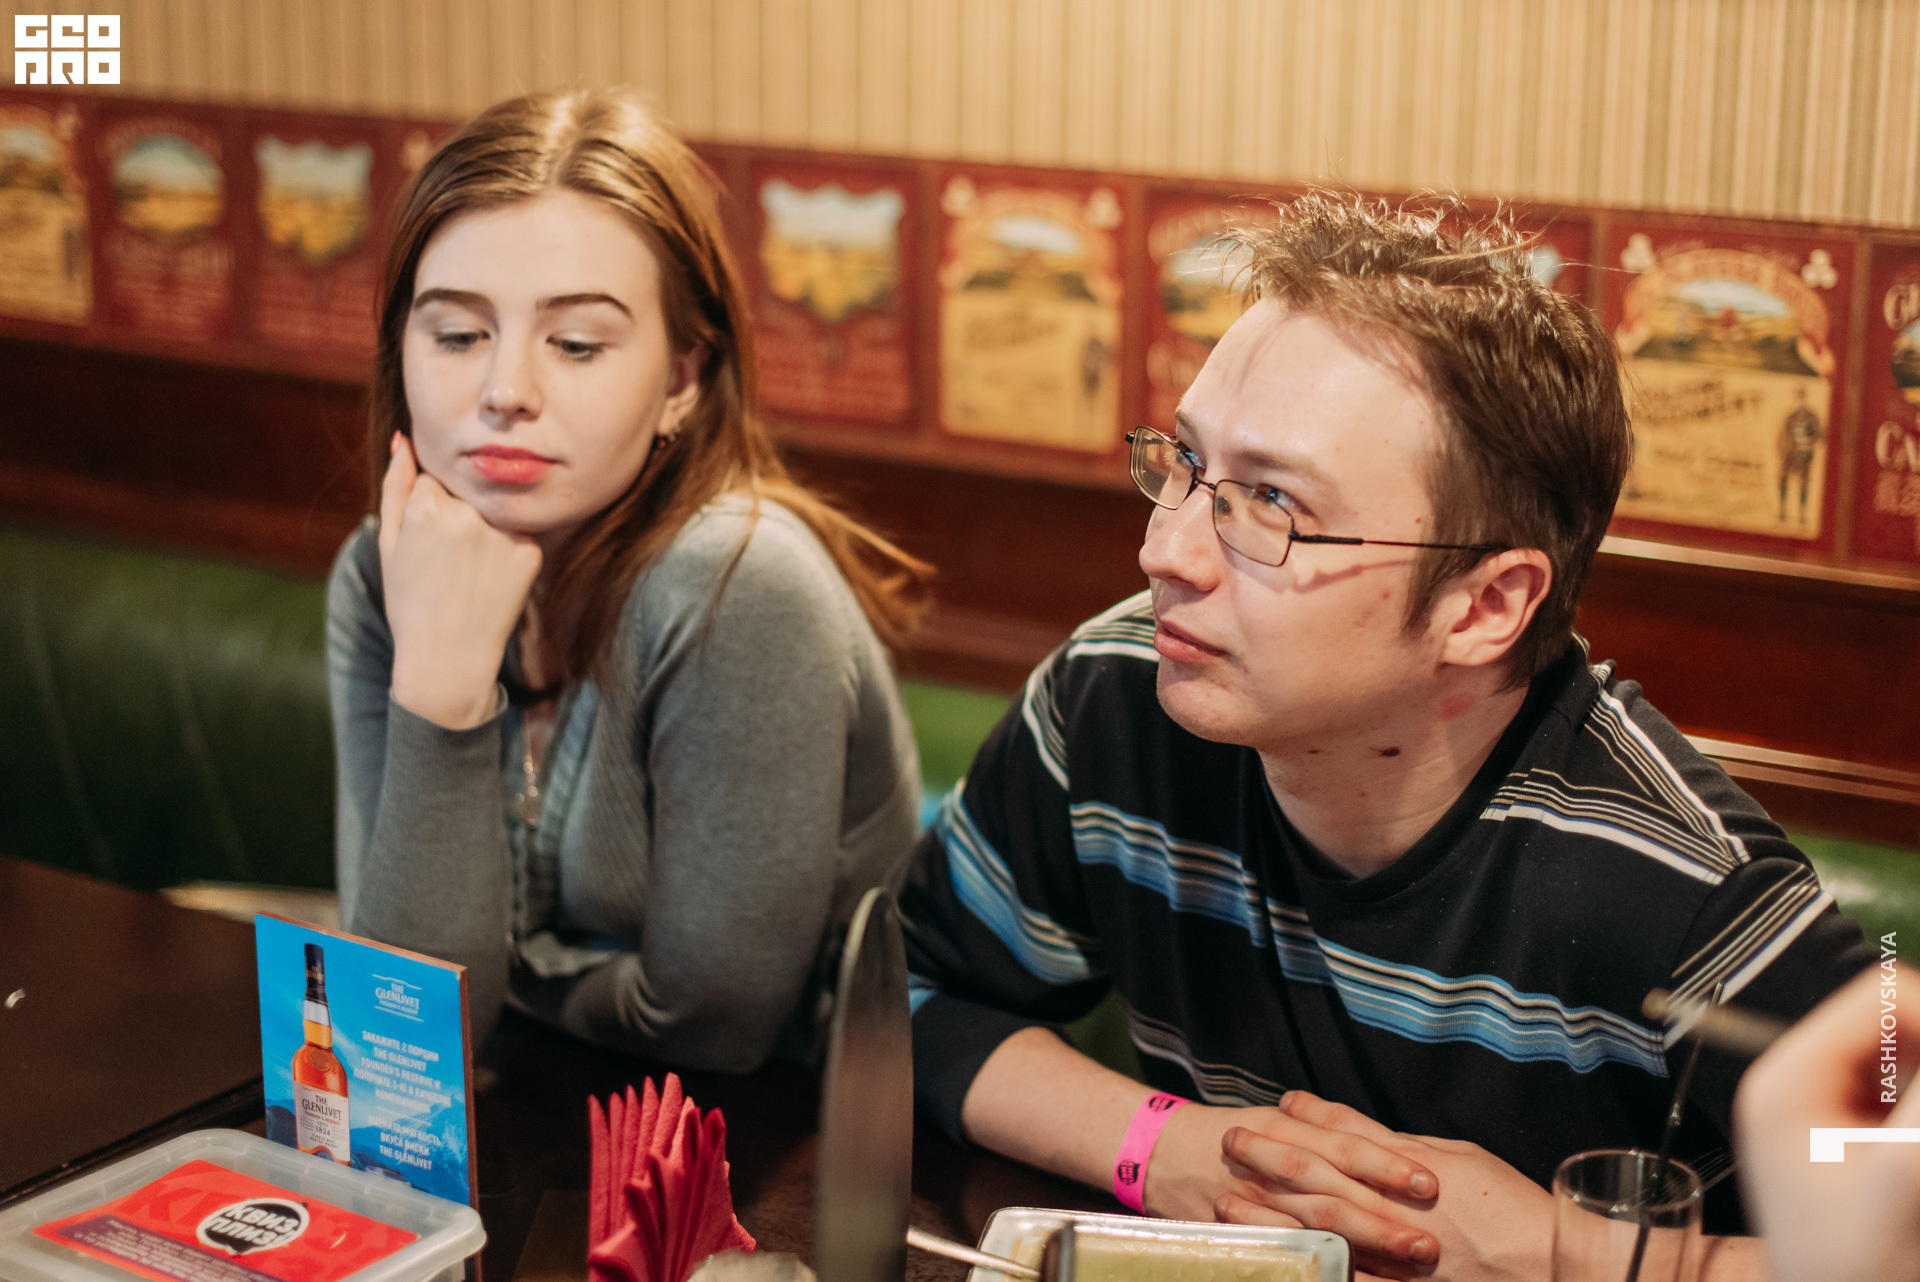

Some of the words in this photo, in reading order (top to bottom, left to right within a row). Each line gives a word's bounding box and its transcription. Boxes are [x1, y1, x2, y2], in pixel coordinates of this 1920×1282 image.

[375, 987, 419, 1010] GLENLIVET
[391, 982, 404, 993] THE
[362, 1030, 400, 1051] ЗАКАЖИТЕ
[401, 1042, 407, 1053] 2
[408, 1044, 439, 1062] ПОРЦИИ
[373, 1046, 387, 1060] THE
[389, 1052, 426, 1072] GLENLIVET
[361, 1057, 400, 1077] FOUNDER'S
[401, 1069, 433, 1088] RESERVE
[354, 1067, 391, 1088] ПОЛУЧИТЕ
[415, 1088, 452, 1108] КАЧЕСТВЕ
[302, 1098, 341, 1120] GLENLIVET
[315, 1095, 328, 1106] THE
[315, 1125, 331, 1136] 1824
[401, 1125, 441, 1146] МЯГКОСТЬ
[380, 1131, 403, 1148] ВКУСА
[404, 1139, 430, 1156] ВИСКИ
[379, 1144, 393, 1159] THE
[394, 1149, 432, 1170] GLENLIVET
